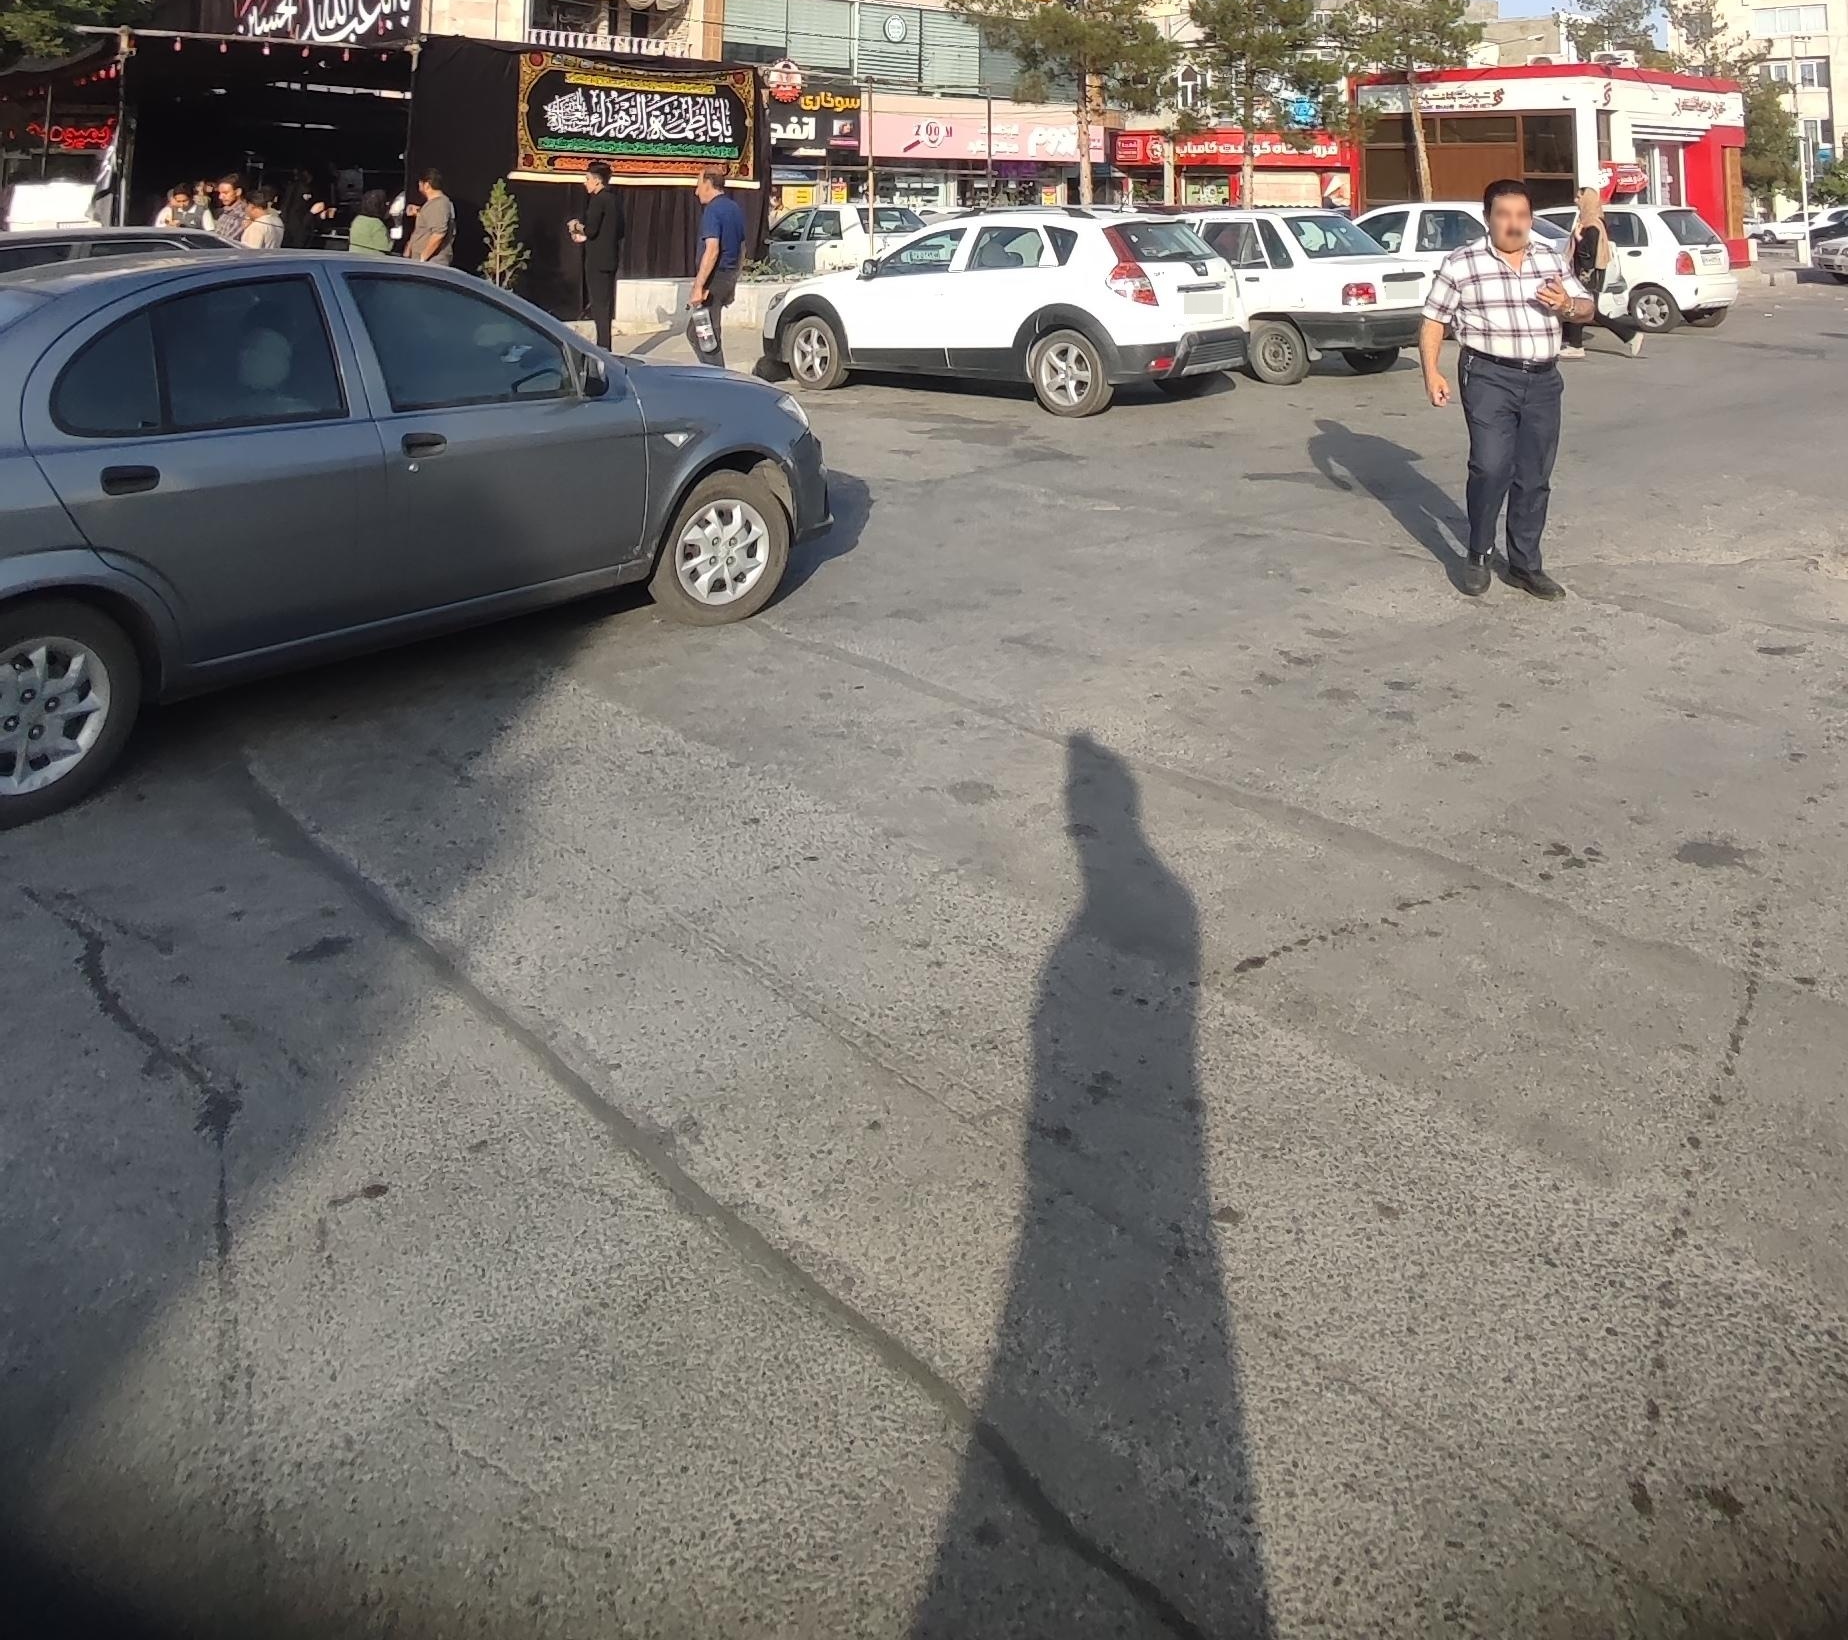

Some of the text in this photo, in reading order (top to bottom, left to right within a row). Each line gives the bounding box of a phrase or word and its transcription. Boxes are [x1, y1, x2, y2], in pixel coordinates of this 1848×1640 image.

[801, 91, 861, 112] سوخاری
[770, 116, 816, 145] انفج
[1175, 140, 1218, 159] کامیاب
[1272, 140, 1339, 158] فرواه
